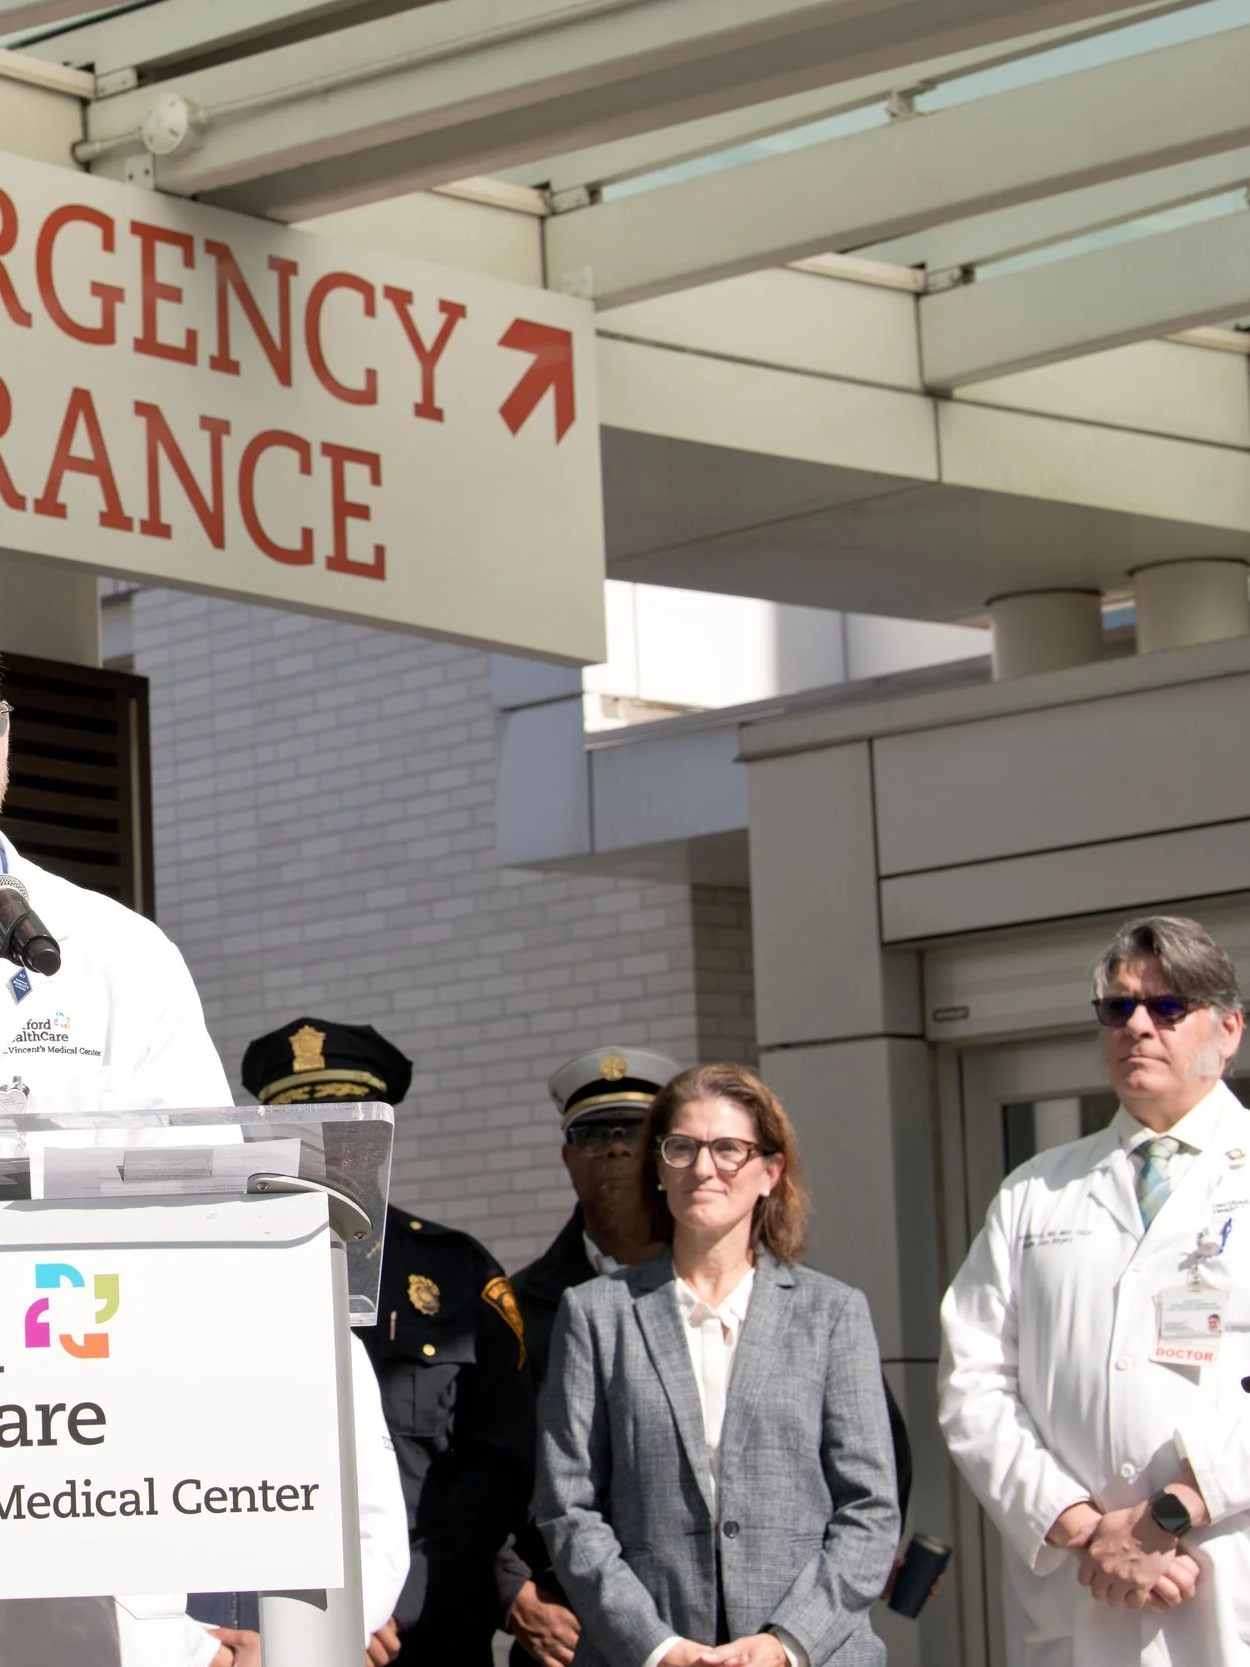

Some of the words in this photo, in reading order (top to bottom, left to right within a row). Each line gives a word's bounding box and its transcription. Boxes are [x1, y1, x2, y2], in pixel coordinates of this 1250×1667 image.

[22, 1019, 52, 1030] ford
[12, 1031, 69, 1042] althCare
[8, 1045, 46, 1055] Vincent's
[48, 1046, 77, 1055] Medical
[79, 1047, 102, 1057] Center
[1155, 1347, 1214, 1362] DOCTOR
[172, 1478, 320, 1515] Center
